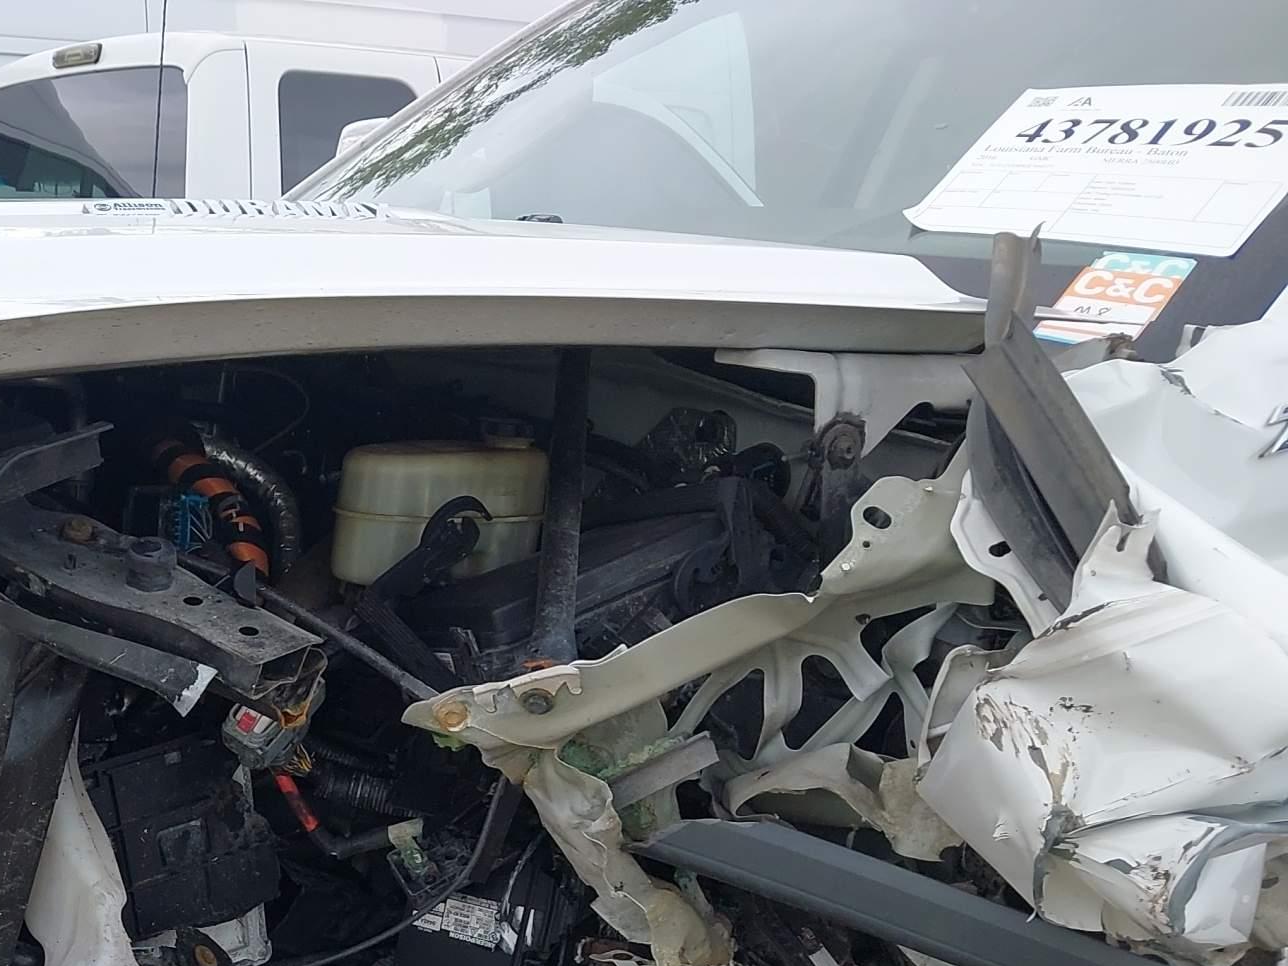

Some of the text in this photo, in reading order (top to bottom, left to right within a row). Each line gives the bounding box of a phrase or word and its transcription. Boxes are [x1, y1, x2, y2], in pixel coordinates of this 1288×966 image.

[1015, 118, 1288, 148] 43781925
[1048, 145, 1082, 153] Farm
[1085, 146, 1133, 155] Bureau
[1146, 147, 1189, 157] Baton
[1074, 270, 1174, 304] C&C
